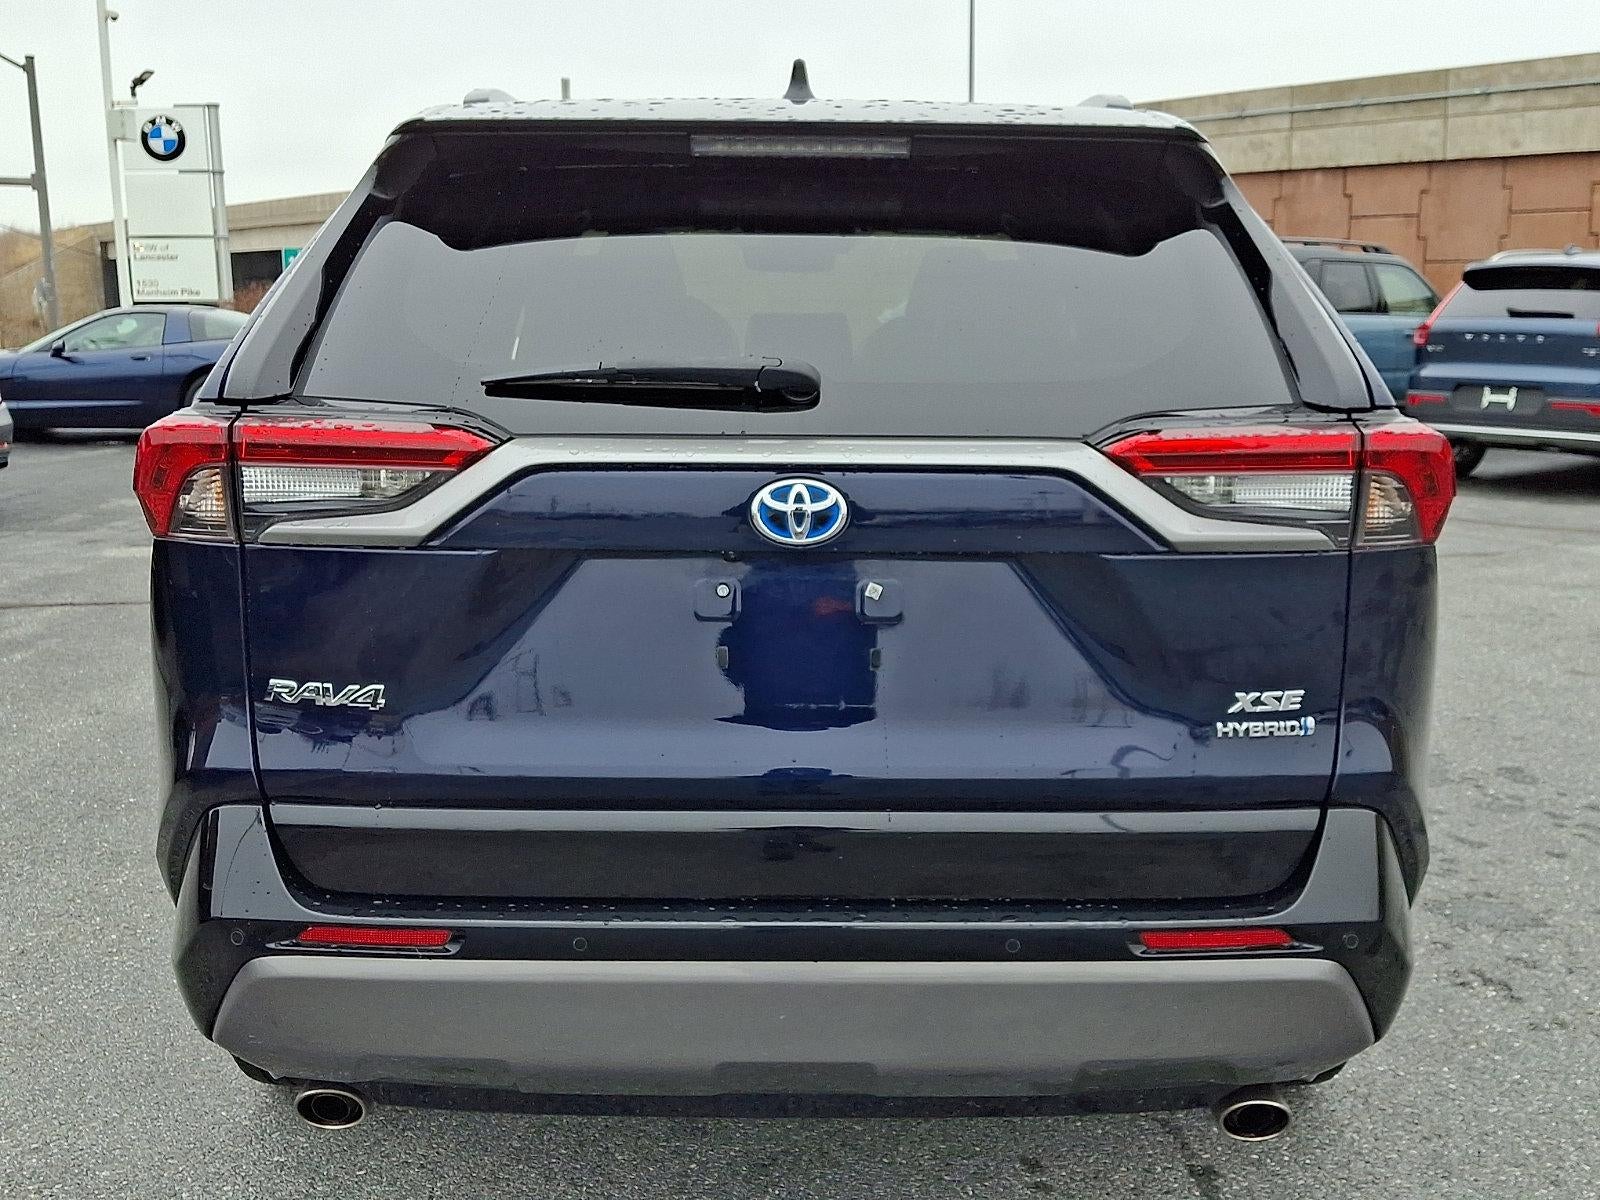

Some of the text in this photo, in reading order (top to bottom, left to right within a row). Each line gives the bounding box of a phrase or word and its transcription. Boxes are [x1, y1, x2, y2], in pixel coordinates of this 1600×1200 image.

[180, 287, 201, 295] Pike
[264, 678, 386, 711] RAV4
[1227, 689, 1306, 714] XSE
[1216, 720, 1301, 738] HYBRID
